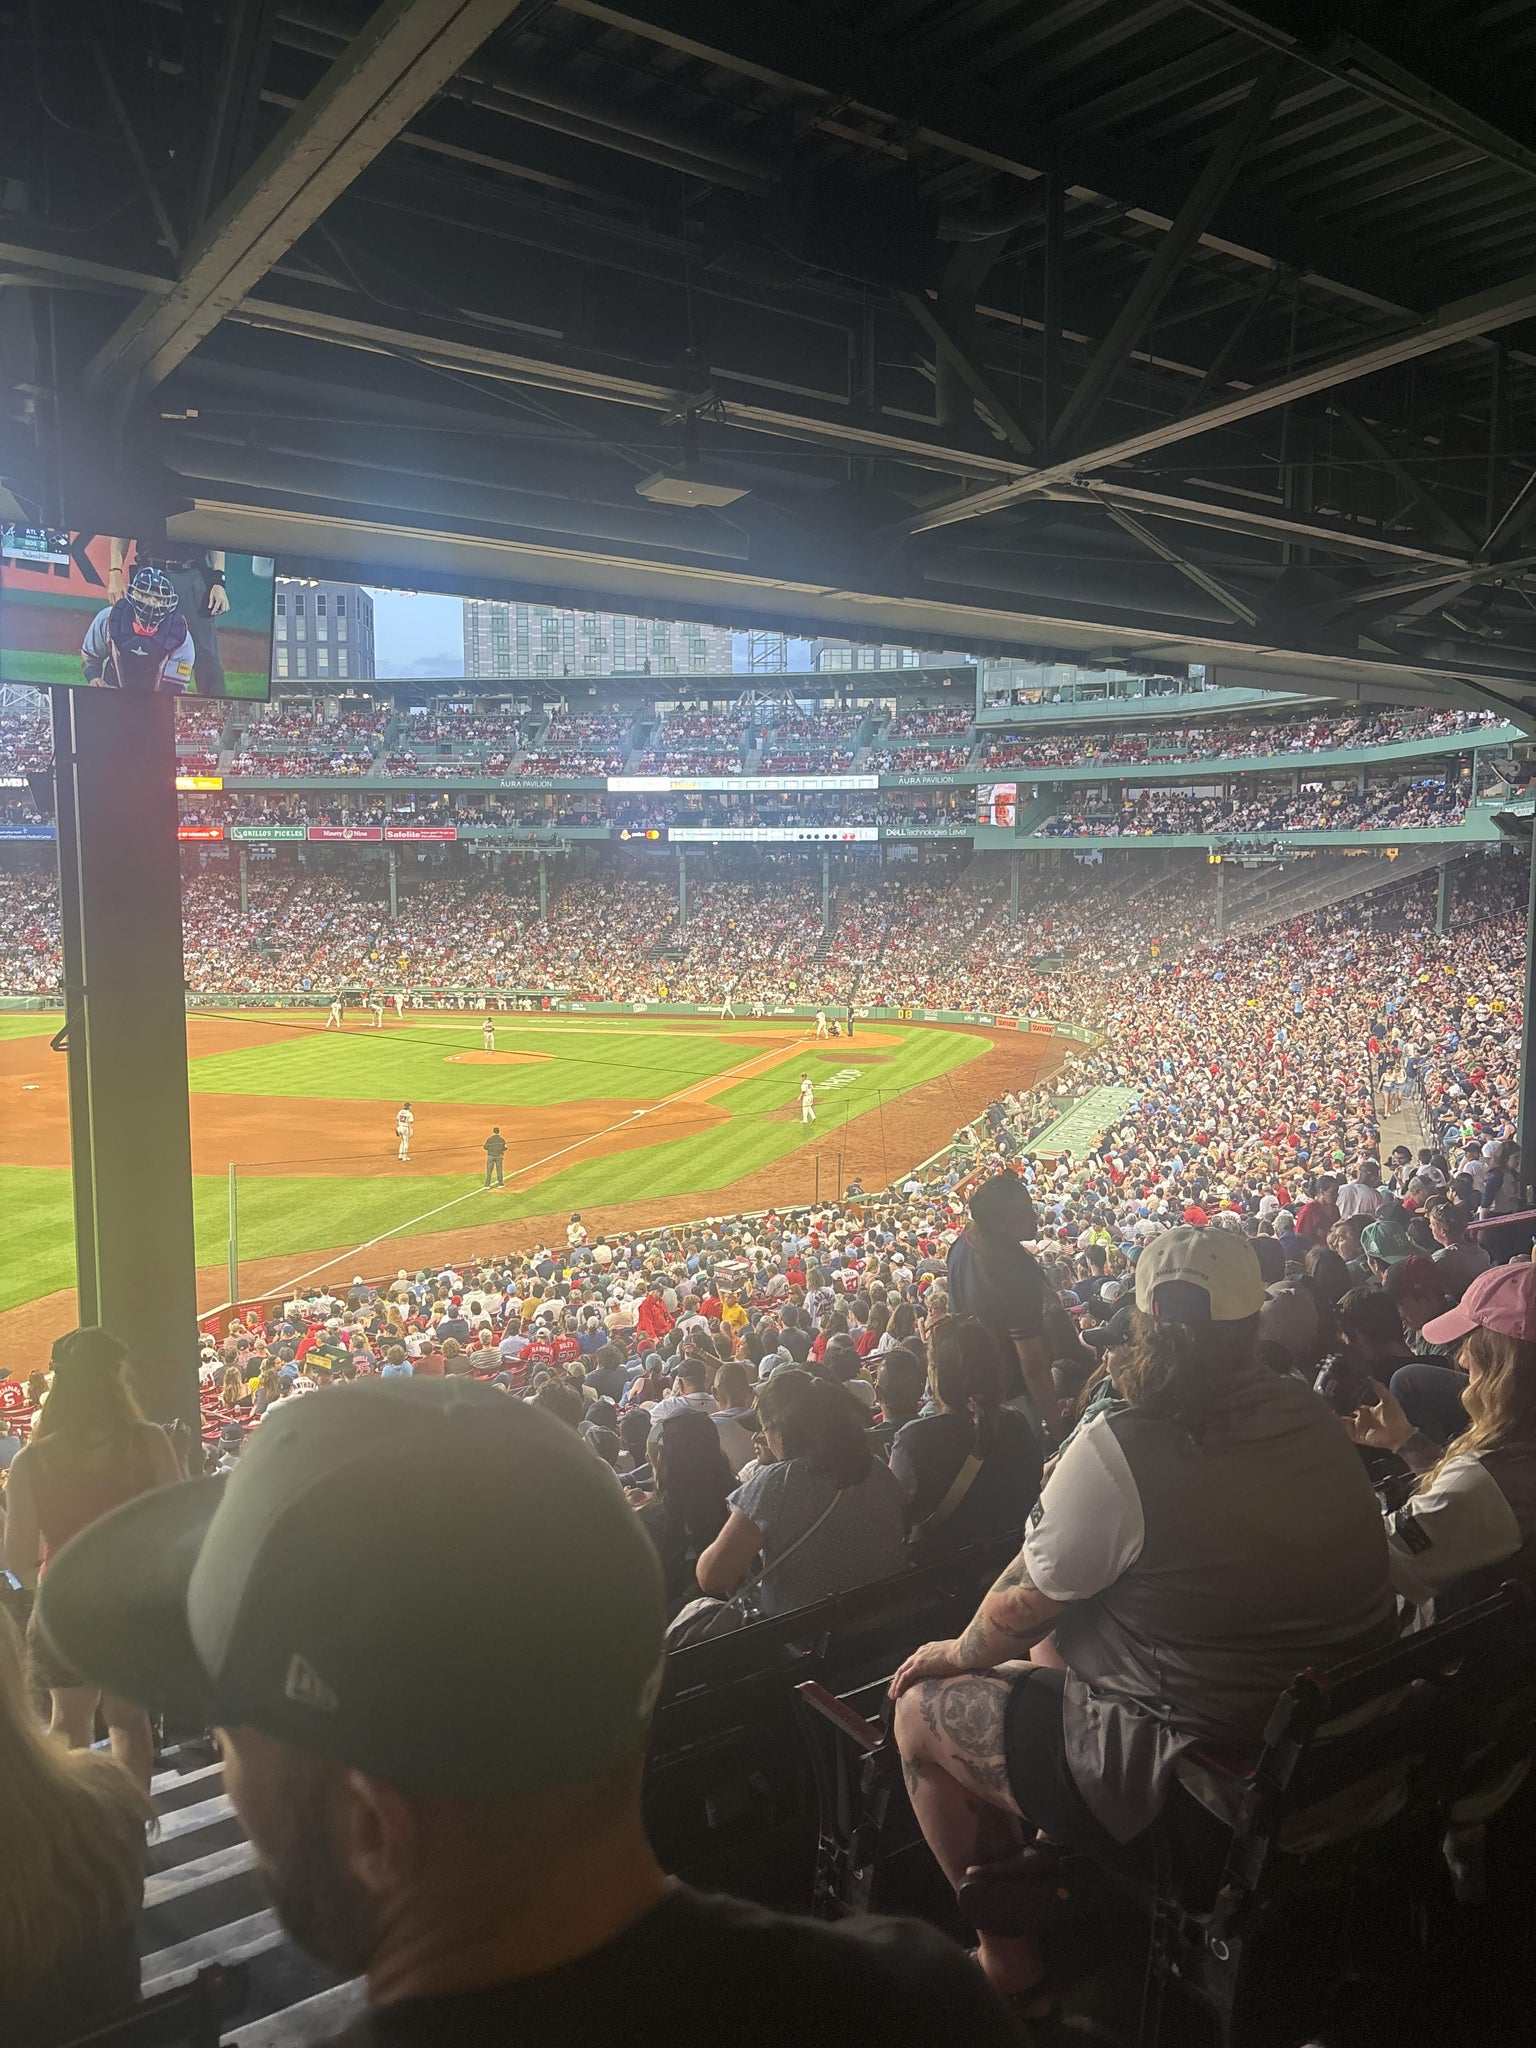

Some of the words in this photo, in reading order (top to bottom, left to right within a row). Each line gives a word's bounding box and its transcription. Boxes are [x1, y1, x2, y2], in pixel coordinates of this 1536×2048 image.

[40, 529, 46, 537] 2
[522, 780, 553, 788] PAVILION
[922, 776, 954, 784] PAVILION
[323, 830, 343, 838] Ninety
[387, 830, 421, 838] Safelite
[886, 828, 906, 836] DELL
[906, 828, 948, 838] Technologies
[949, 828, 967, 836] Level
[558, 1341, 574, 1350] RILEY
[4, 1392, 15, 1407] 5
